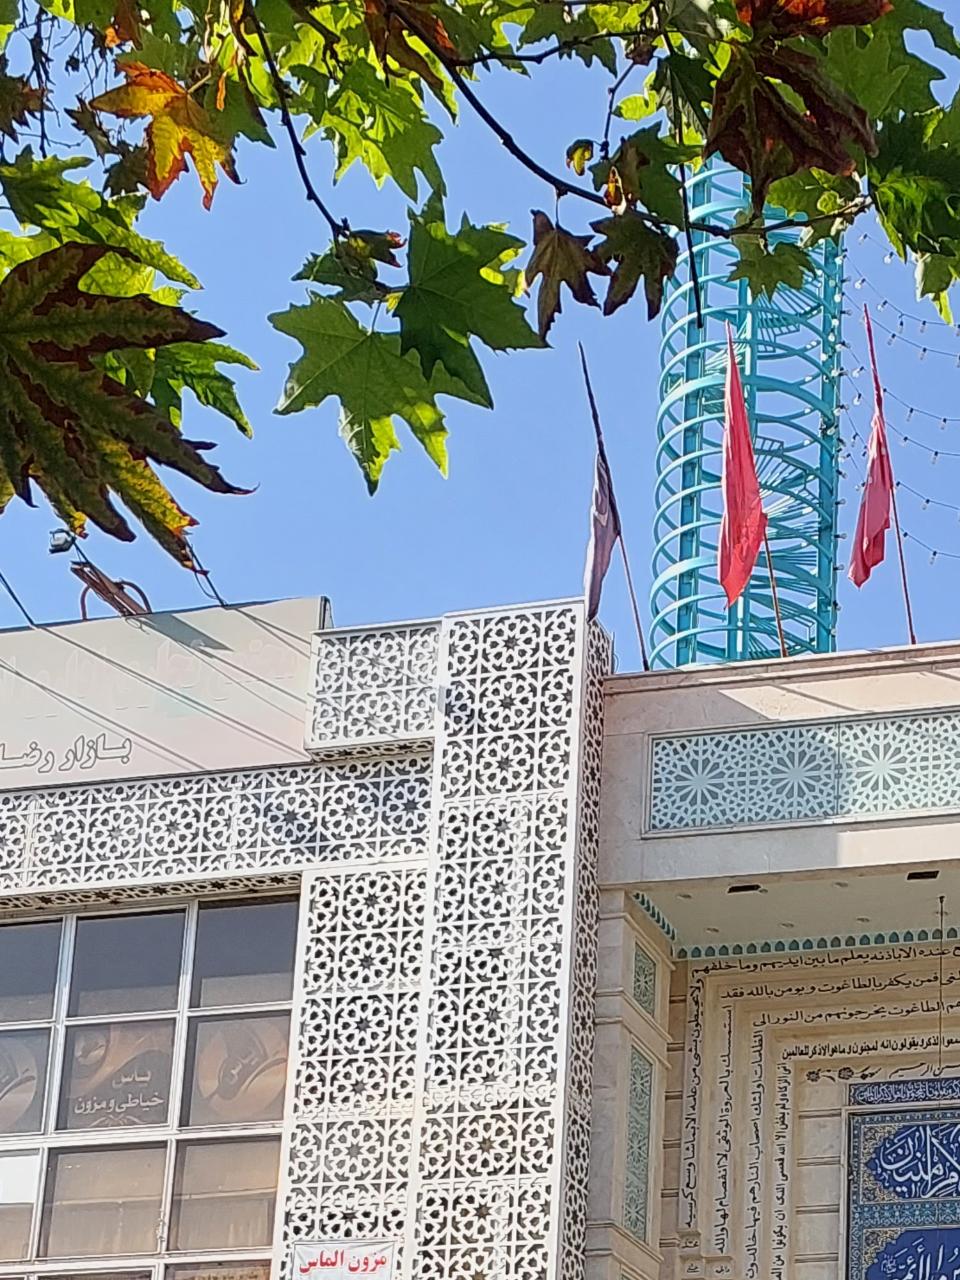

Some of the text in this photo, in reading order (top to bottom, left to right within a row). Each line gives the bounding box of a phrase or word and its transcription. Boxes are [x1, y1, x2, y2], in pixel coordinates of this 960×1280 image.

[59, 733, 132, 771] بازار
[74, 1097, 106, 1114] مزون
[115, 1091, 164, 1112] خیاطی
[299, 1249, 388, 1274] مزون الماس
